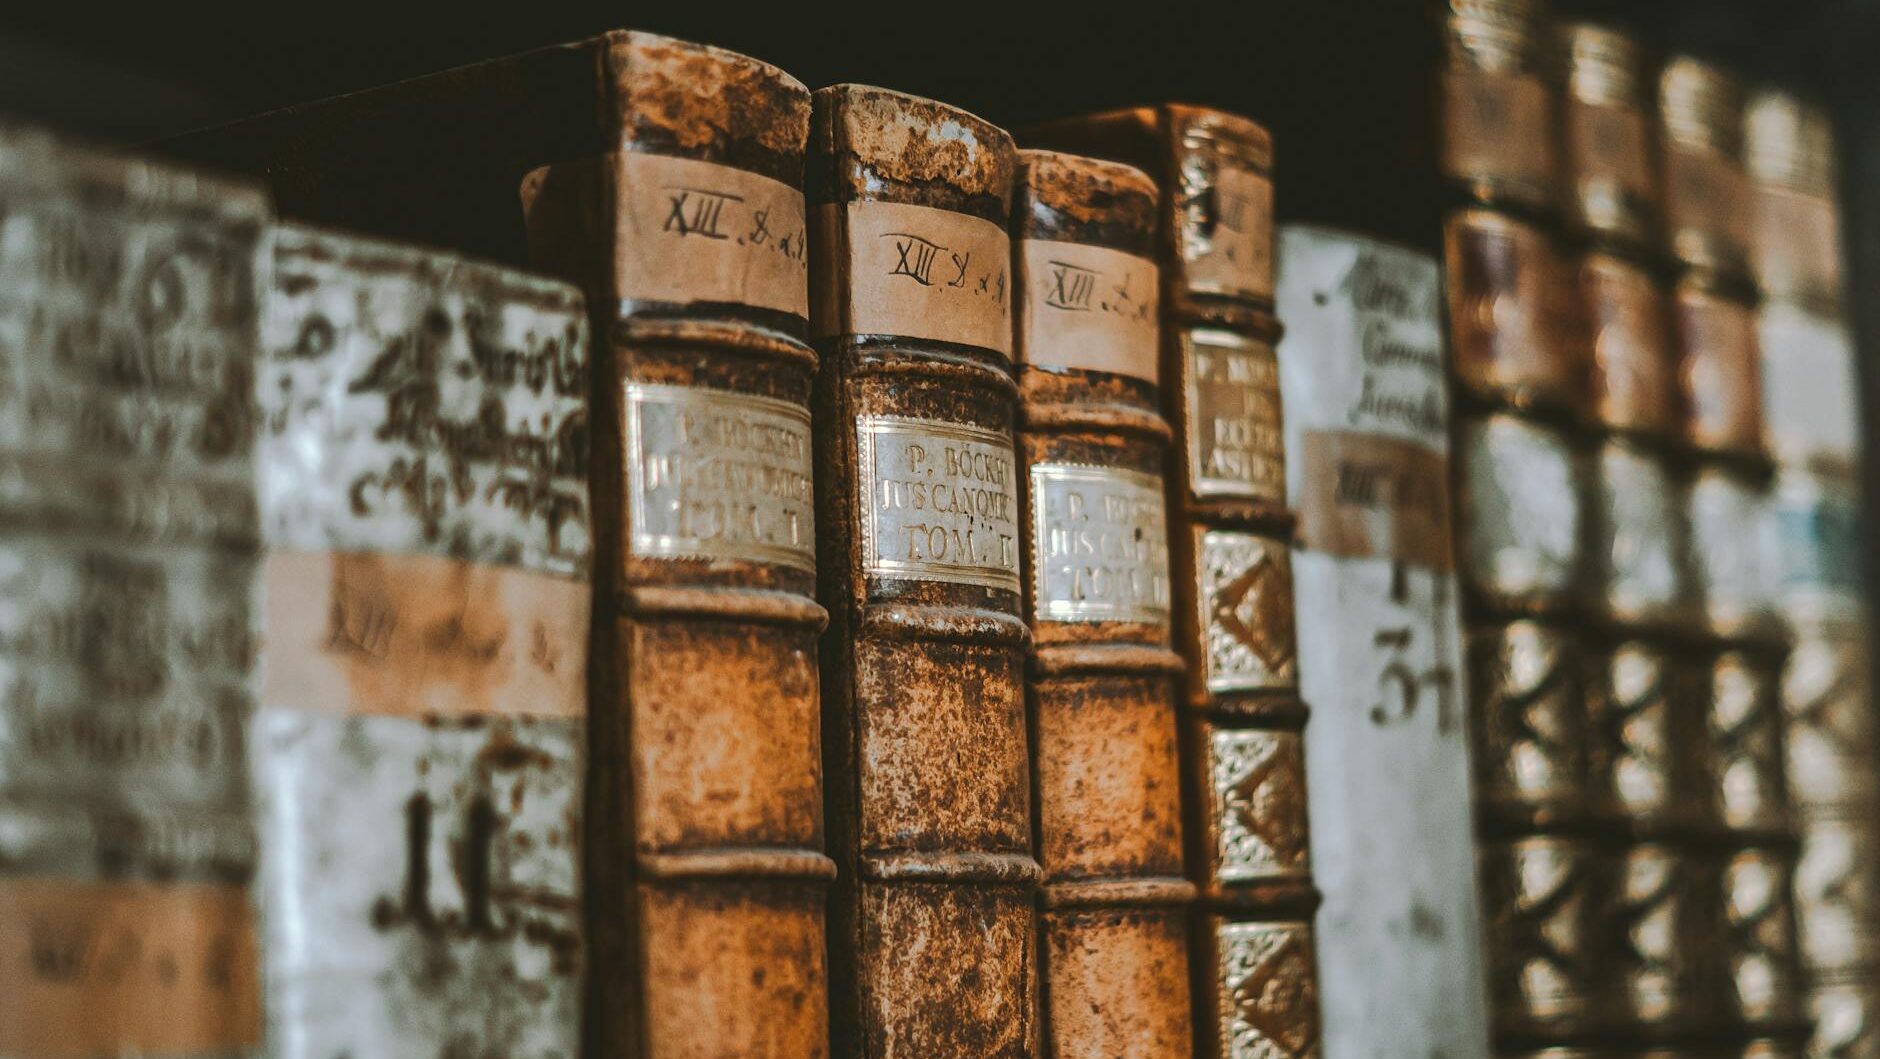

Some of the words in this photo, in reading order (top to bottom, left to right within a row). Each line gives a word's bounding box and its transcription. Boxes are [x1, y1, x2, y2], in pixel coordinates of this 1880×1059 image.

[905, 443, 934, 478] P.
[881, 479, 927, 511] JUS
[902, 522, 988, 564] TOM.
